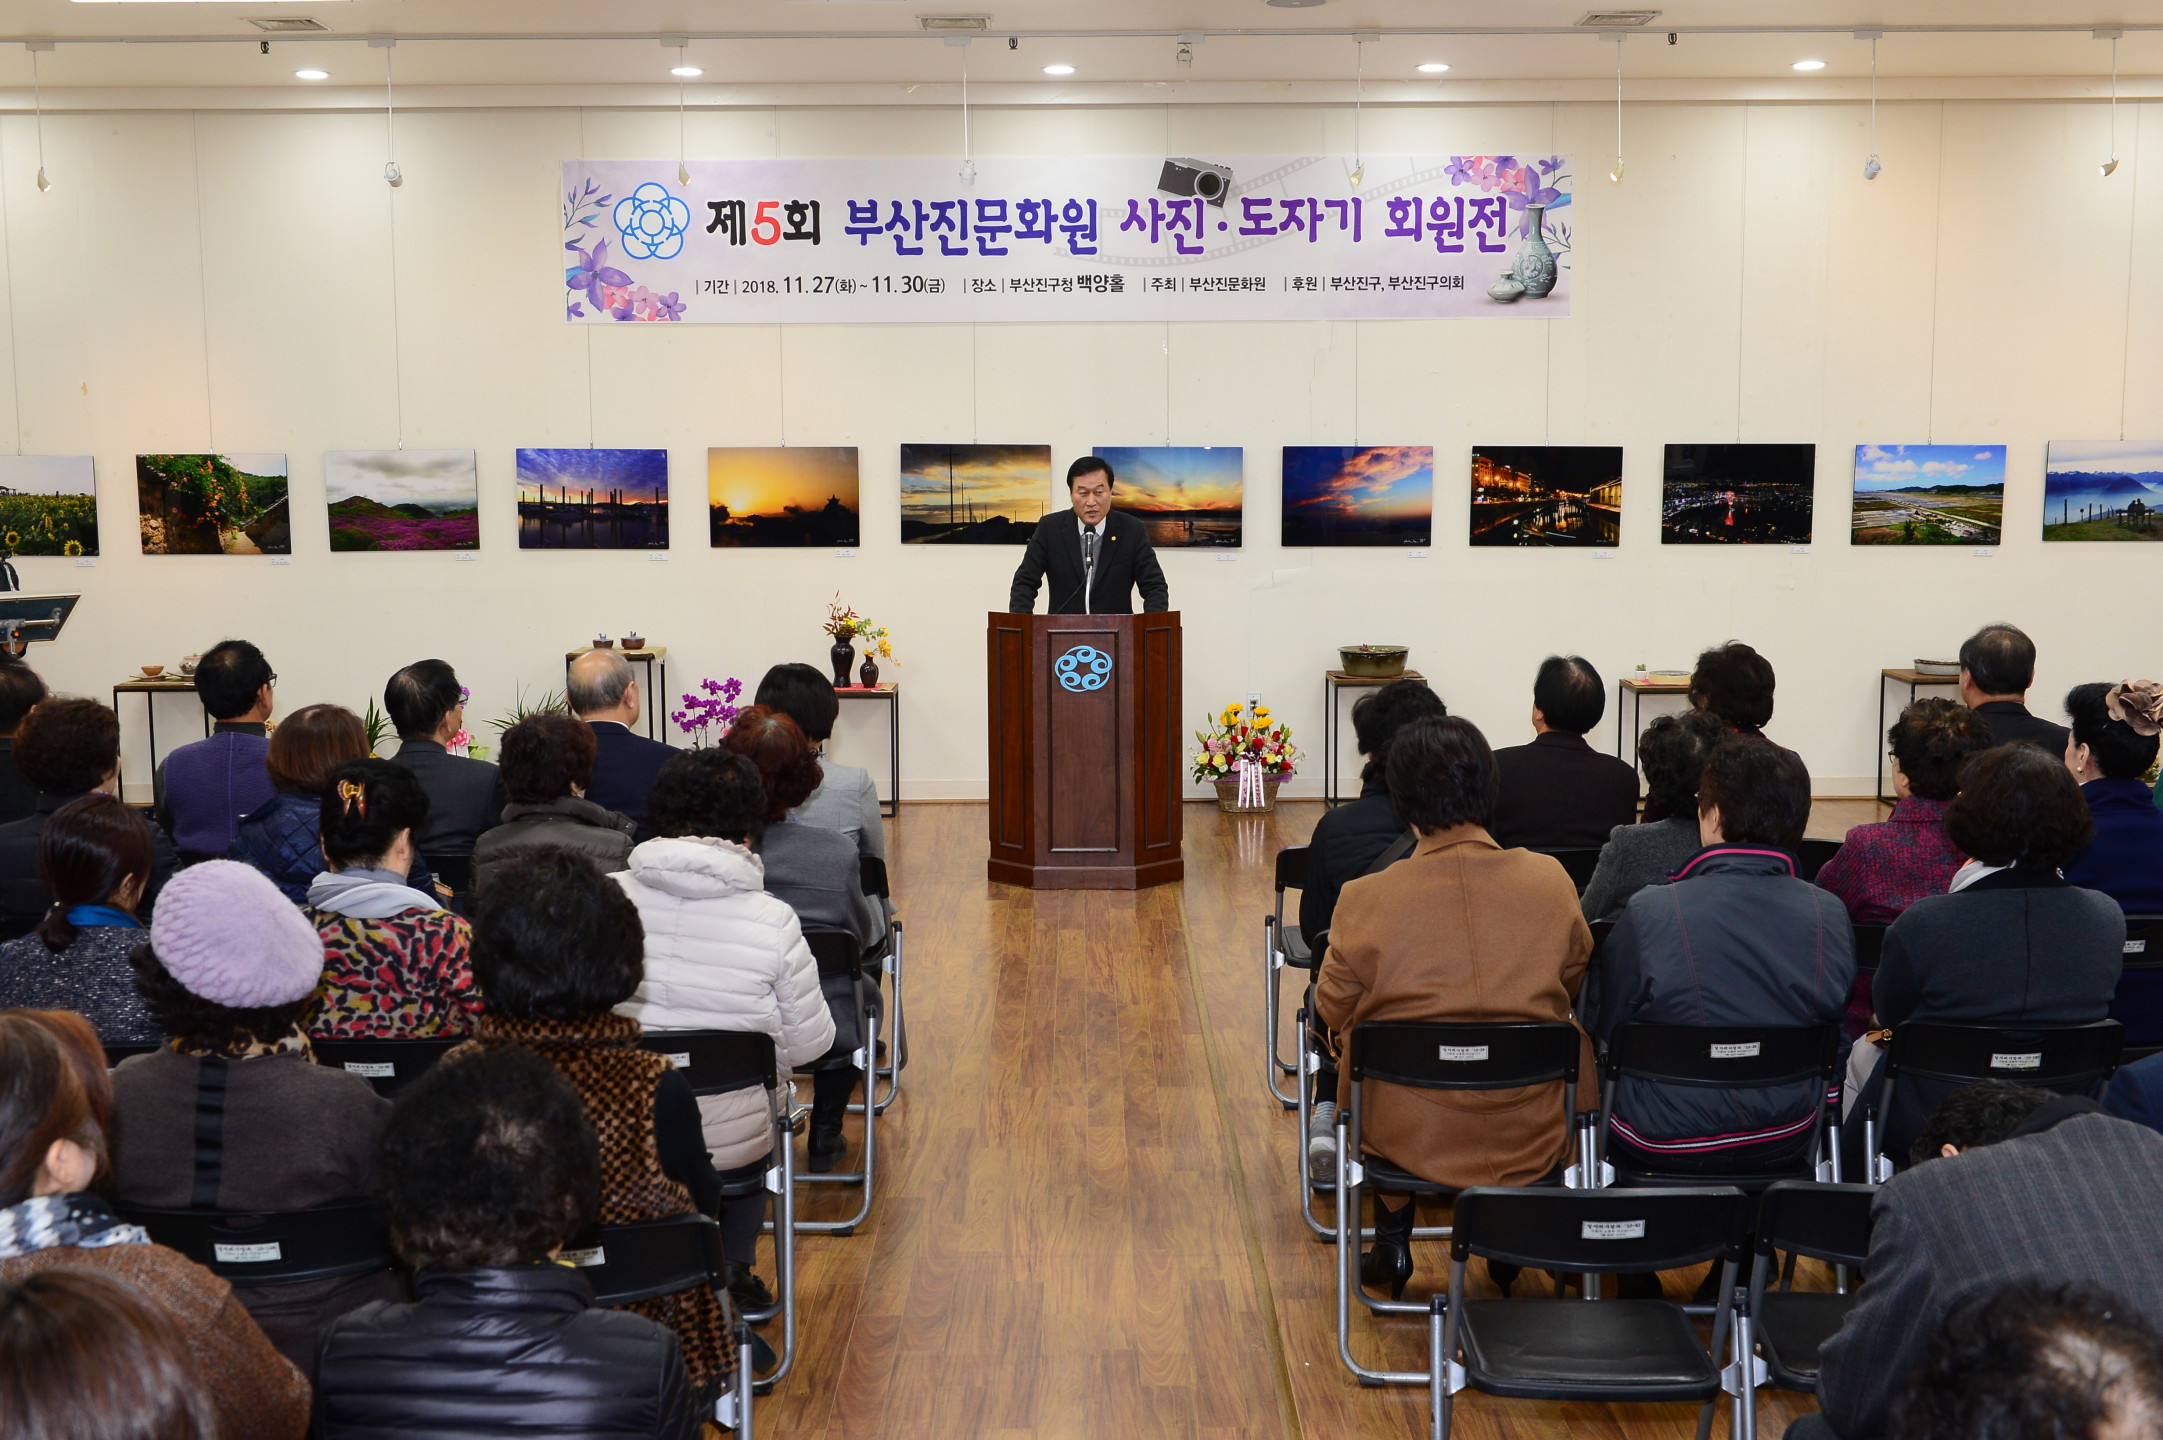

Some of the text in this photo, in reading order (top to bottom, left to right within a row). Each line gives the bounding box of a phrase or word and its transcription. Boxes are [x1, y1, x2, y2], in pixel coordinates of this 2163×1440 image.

[706, 199, 821, 246] 제5회
[844, 198, 1098, 257] 부산진문화원
[1384, 196, 1507, 253] 회원전
[704, 279, 730, 295] 기간
[971, 278, 997, 294] 장소
[1009, 277, 1073, 293] 부산진구청
[1077, 273, 1126, 293] 백양홀
[1150, 277, 1177, 293] 주최
[1189, 276, 1266, 292] 부산진문화원
[1291, 276, 1318, 292] 후원
[1329, 276, 1385, 293] 부산진구,
[1387, 275, 1465, 291] 부산진구의회
